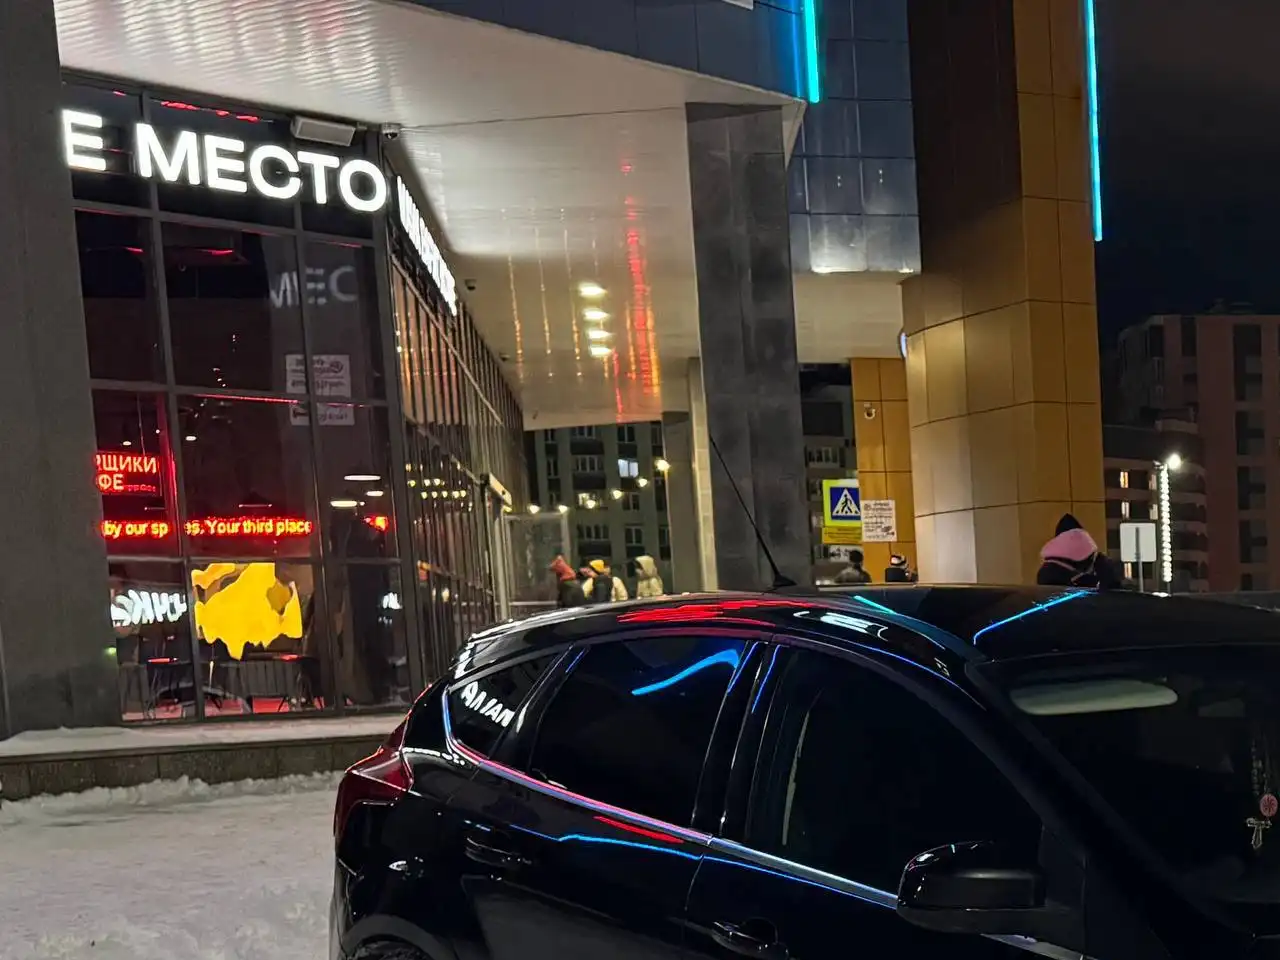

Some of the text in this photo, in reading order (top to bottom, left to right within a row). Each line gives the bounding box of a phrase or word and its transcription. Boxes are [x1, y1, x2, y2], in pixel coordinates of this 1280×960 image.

[134, 123, 387, 212] МЕСТО
[103, 520, 121, 539] by
[125, 522, 148, 535] our
[204, 519, 240, 535] Your
[242, 518, 273, 534] third
[276, 518, 312, 536] place
